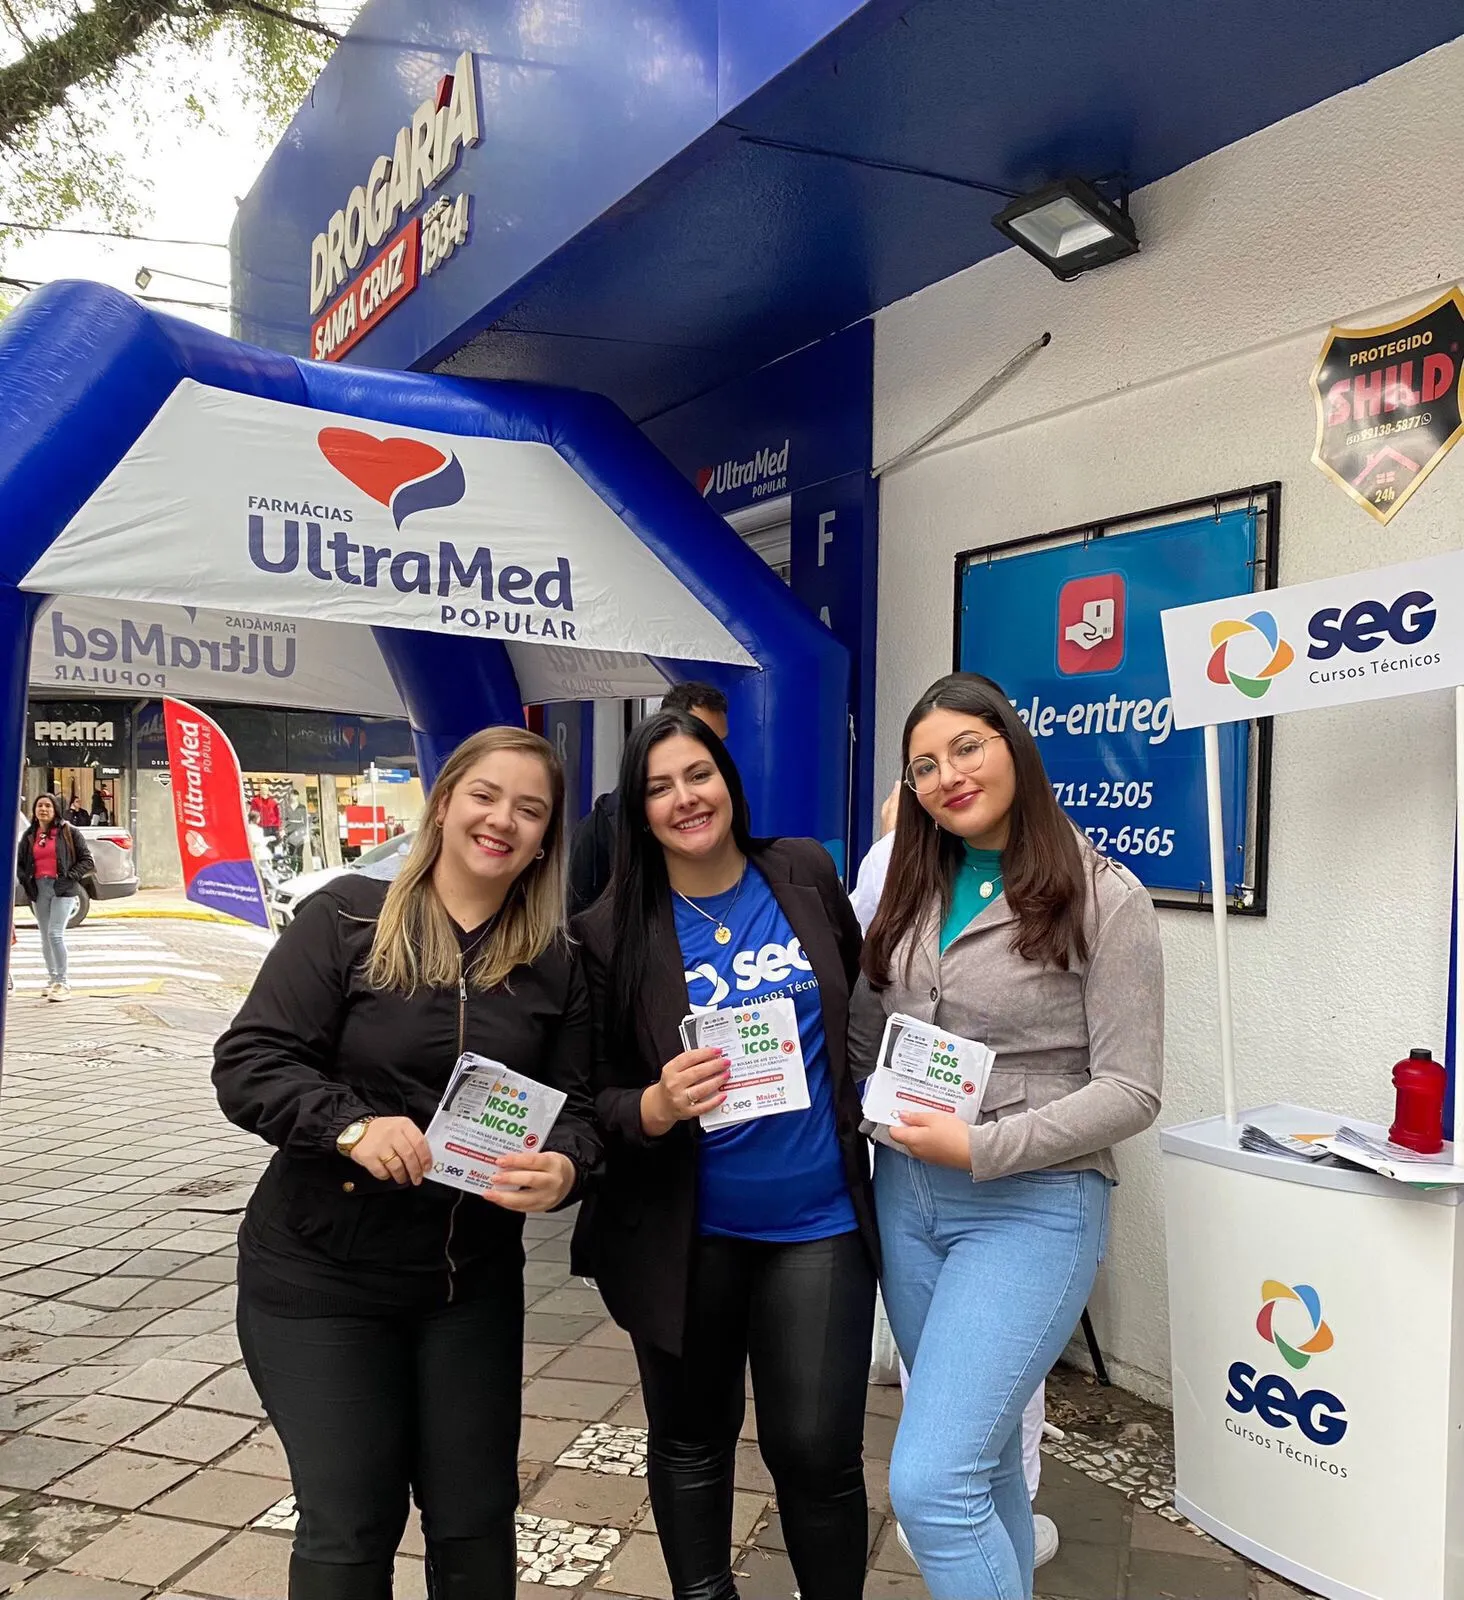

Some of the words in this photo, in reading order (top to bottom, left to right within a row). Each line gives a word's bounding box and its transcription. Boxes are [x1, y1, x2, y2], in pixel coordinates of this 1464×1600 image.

[421, 192, 469, 276] 1934
[315, 290, 357, 360] SANTA
[359, 238, 407, 321] CRUZ
[1349, 331, 1433, 367] PROTEGIDO
[1327, 353, 1454, 427] SHILD
[716, 439, 790, 494] UltraMed
[752, 476, 787, 498] POPULAR
[1374, 486, 1395, 503] 24h
[248, 496, 353, 522] FARMÁCIAS
[248, 514, 575, 611] UltraMed
[441, 605, 577, 641] POPULAR
[1309, 665, 1366, 684] Cursos
[1370, 652, 1442, 677] Técnicos
[34, 721, 114, 741] PRATA
[201, 724, 213, 773] POPULAR
[176, 718, 206, 828] UltraMed
[742, 989, 785, 1007] Cursos
[738, 1022, 770, 1038] SOS
[742, 1038, 779, 1055] ICOS
[931, 1051, 959, 1068] SOS
[1225, 1418, 1271, 1450] Cursos
[1276, 1439, 1349, 1479] Técnicos
